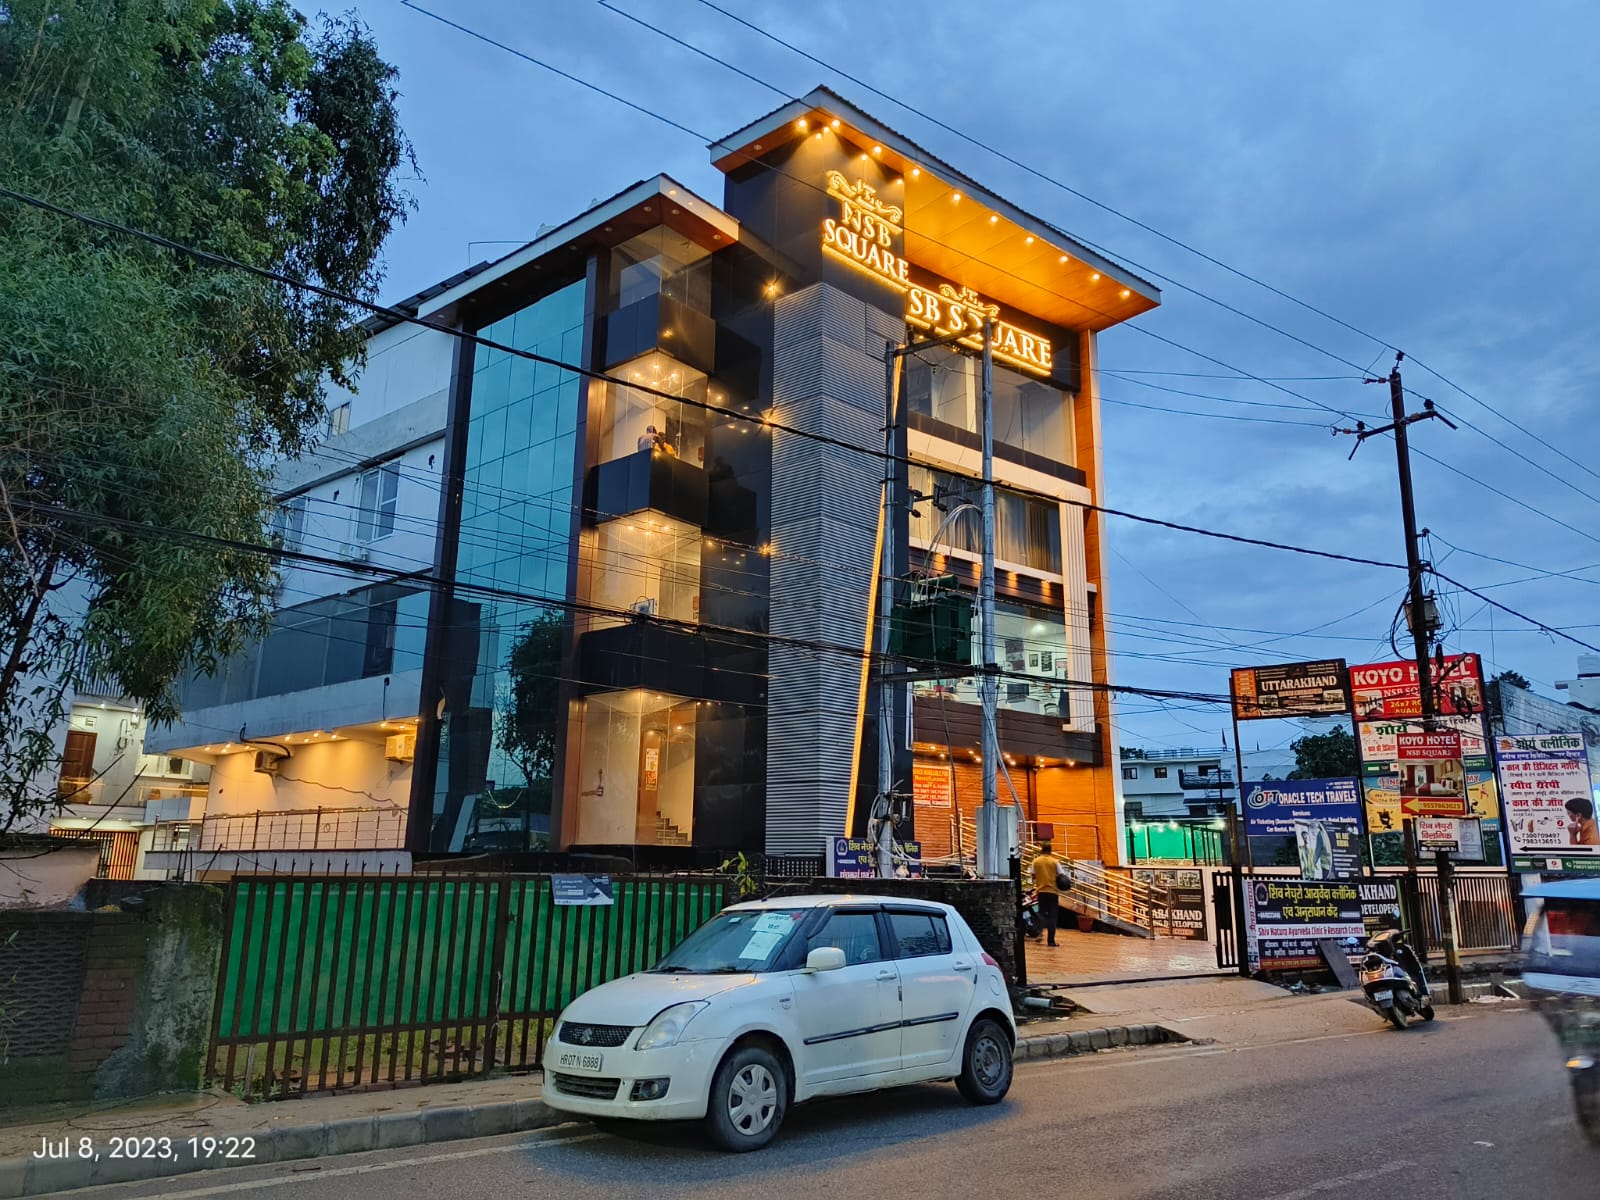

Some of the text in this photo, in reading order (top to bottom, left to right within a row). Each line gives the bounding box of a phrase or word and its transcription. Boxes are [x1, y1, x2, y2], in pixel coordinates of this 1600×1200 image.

[841, 201, 892, 248] NSB
[823, 218, 910, 283] SQUARE
[1353, 667, 1403, 685] KOYO
[1409, 661, 1471, 681] HEL
[1261, 675, 1338, 691] UTTARAKHAND
[1383, 689, 1403, 698] NSB
[1399, 735, 1457, 746] KOYO HOTEL
[1406, 750, 1421, 758] NSB
[1422, 749, 1452, 758] SQUARE
[1279, 791, 1306, 805] ORACLE
[1306, 791, 1325, 804] TECH
[1326, 789, 1358, 803] TRAVELS
[1268, 883, 1284, 900] शिव
[560, 1054, 599, 1068] HR07 N 6888
